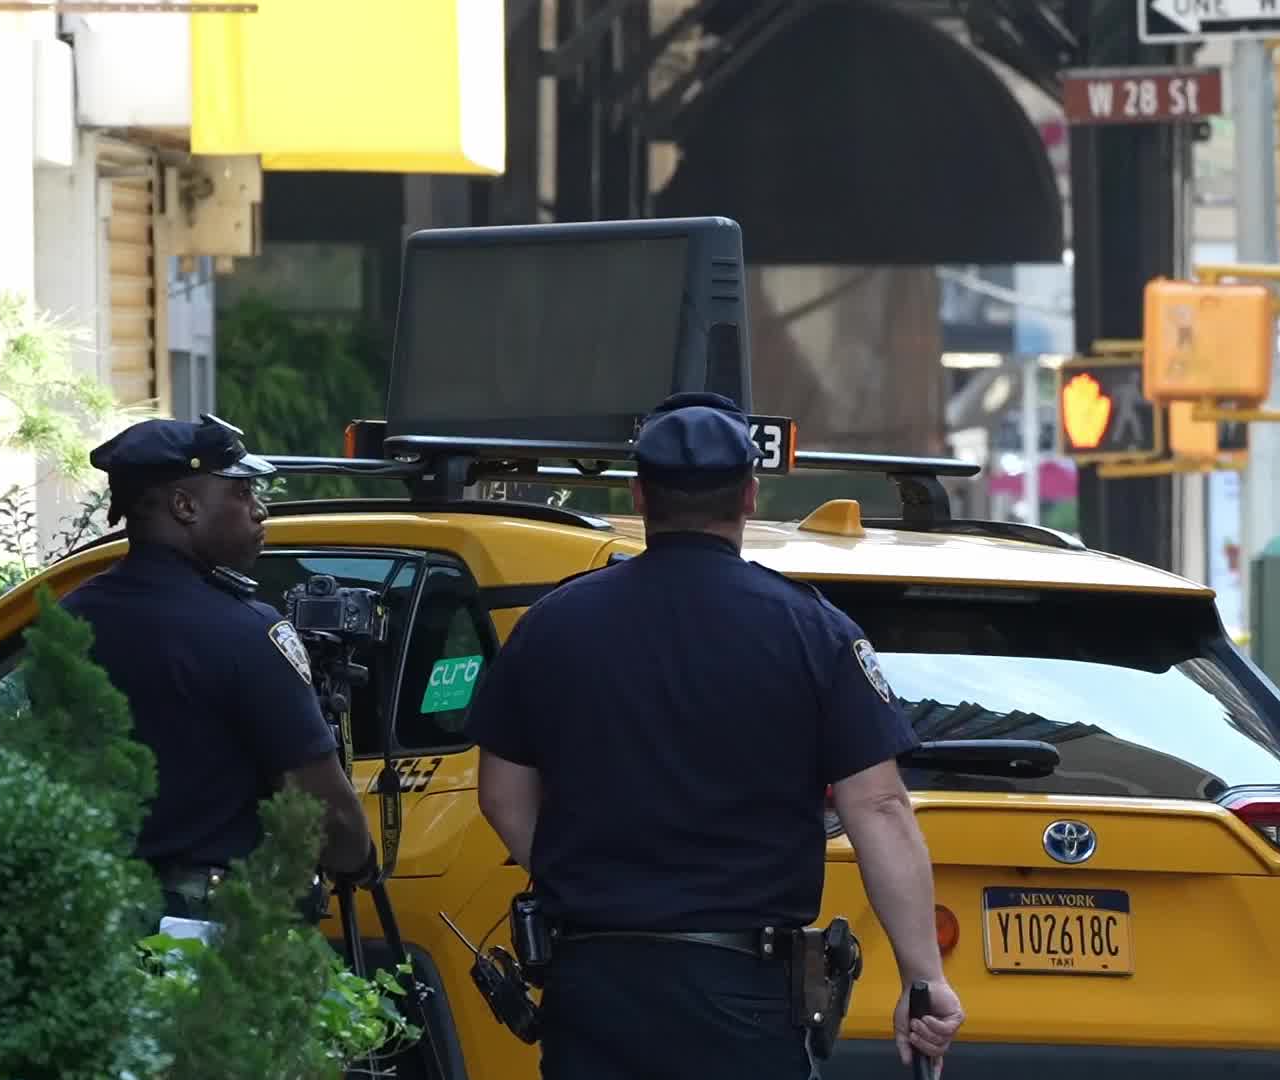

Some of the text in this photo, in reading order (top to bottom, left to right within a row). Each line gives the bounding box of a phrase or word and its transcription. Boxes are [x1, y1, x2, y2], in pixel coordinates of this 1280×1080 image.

[1087, 78, 1198, 117] W 28 St
[430, 658, 479, 687] curb
[1021, 893, 1095, 908] NEW YORK
[997, 911, 1119, 957] Y102618C
[1048, 957, 1074, 968] TAXI
